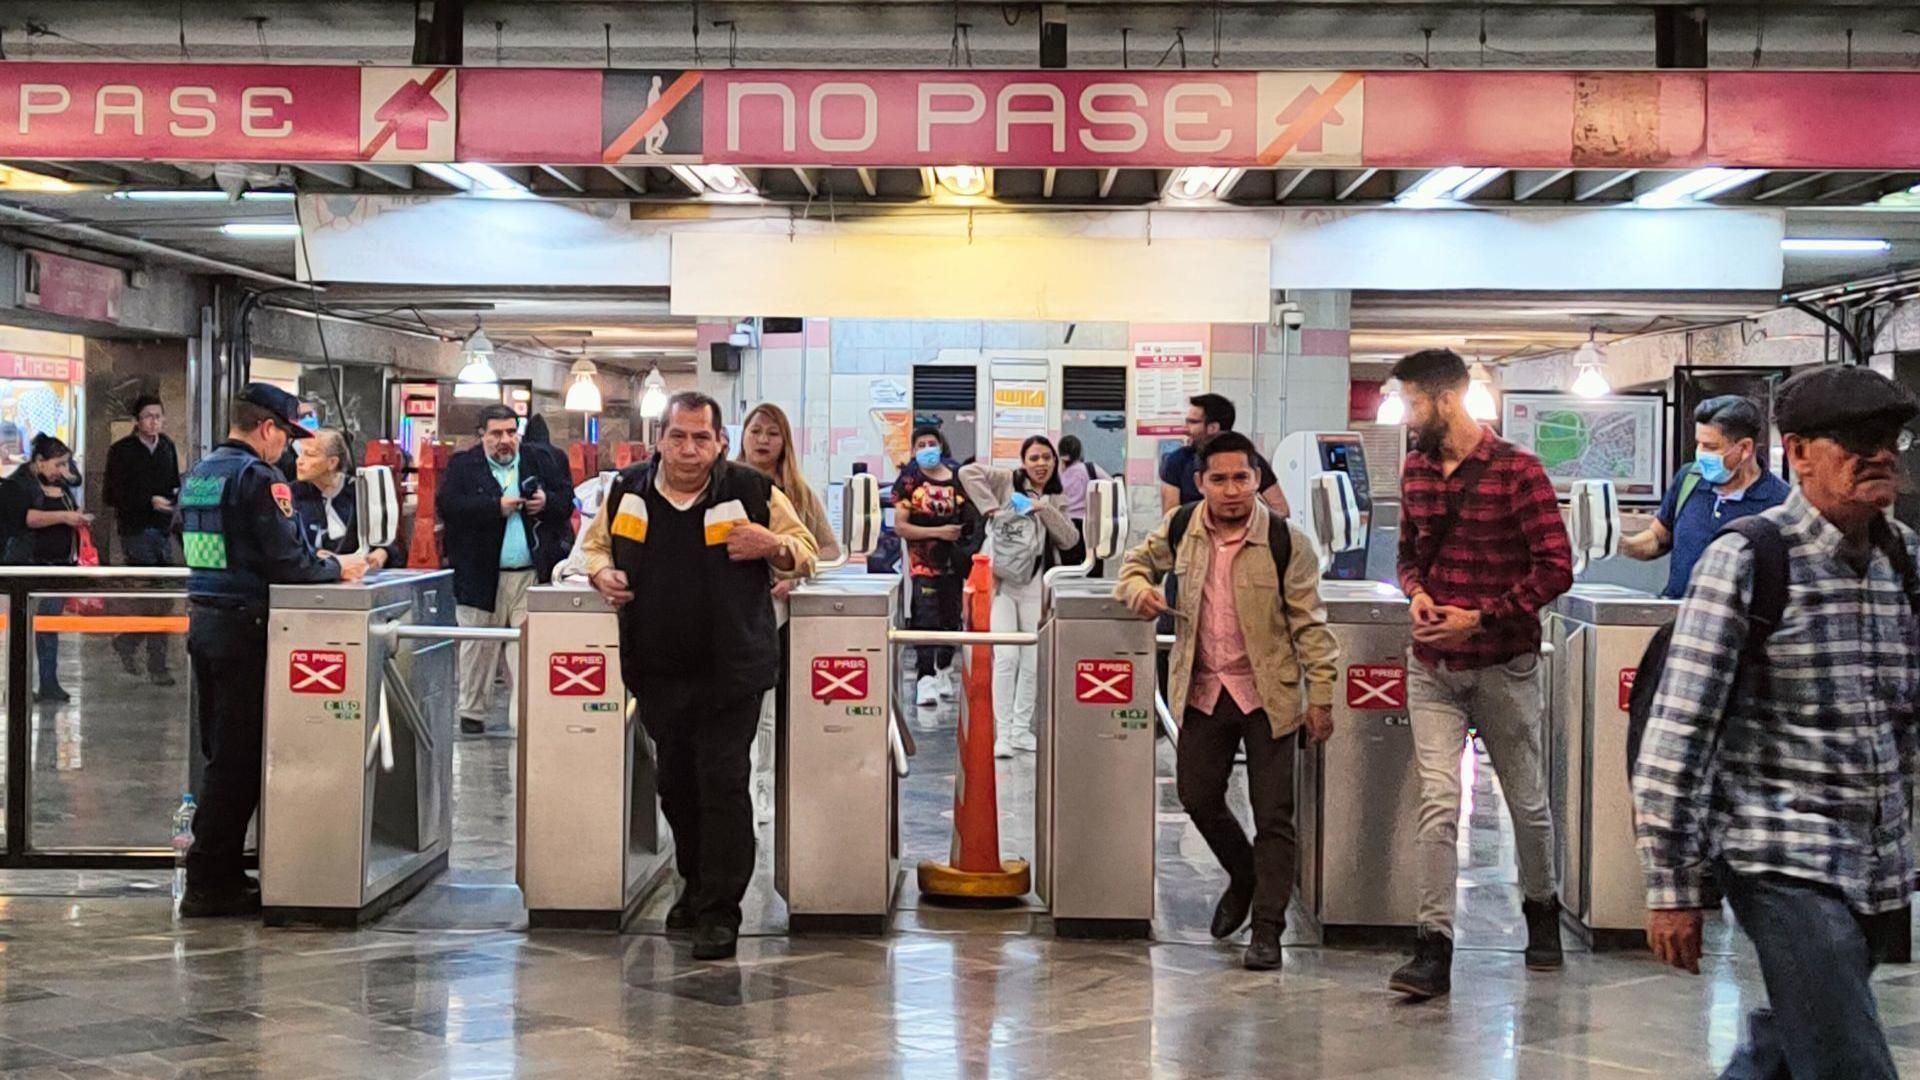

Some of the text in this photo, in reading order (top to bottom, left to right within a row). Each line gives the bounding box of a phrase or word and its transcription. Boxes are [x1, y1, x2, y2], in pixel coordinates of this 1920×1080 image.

[18, 83, 294, 137] PASE
[727, 82, 1233, 152] NO PASE
[291, 653, 344, 663] NO PASE
[551, 655, 603, 664] NO PASE
[813, 660, 866, 668] NO PASE
[1078, 662, 1131, 671] NO PASE
[1349, 668, 1403, 678] NO PASE
